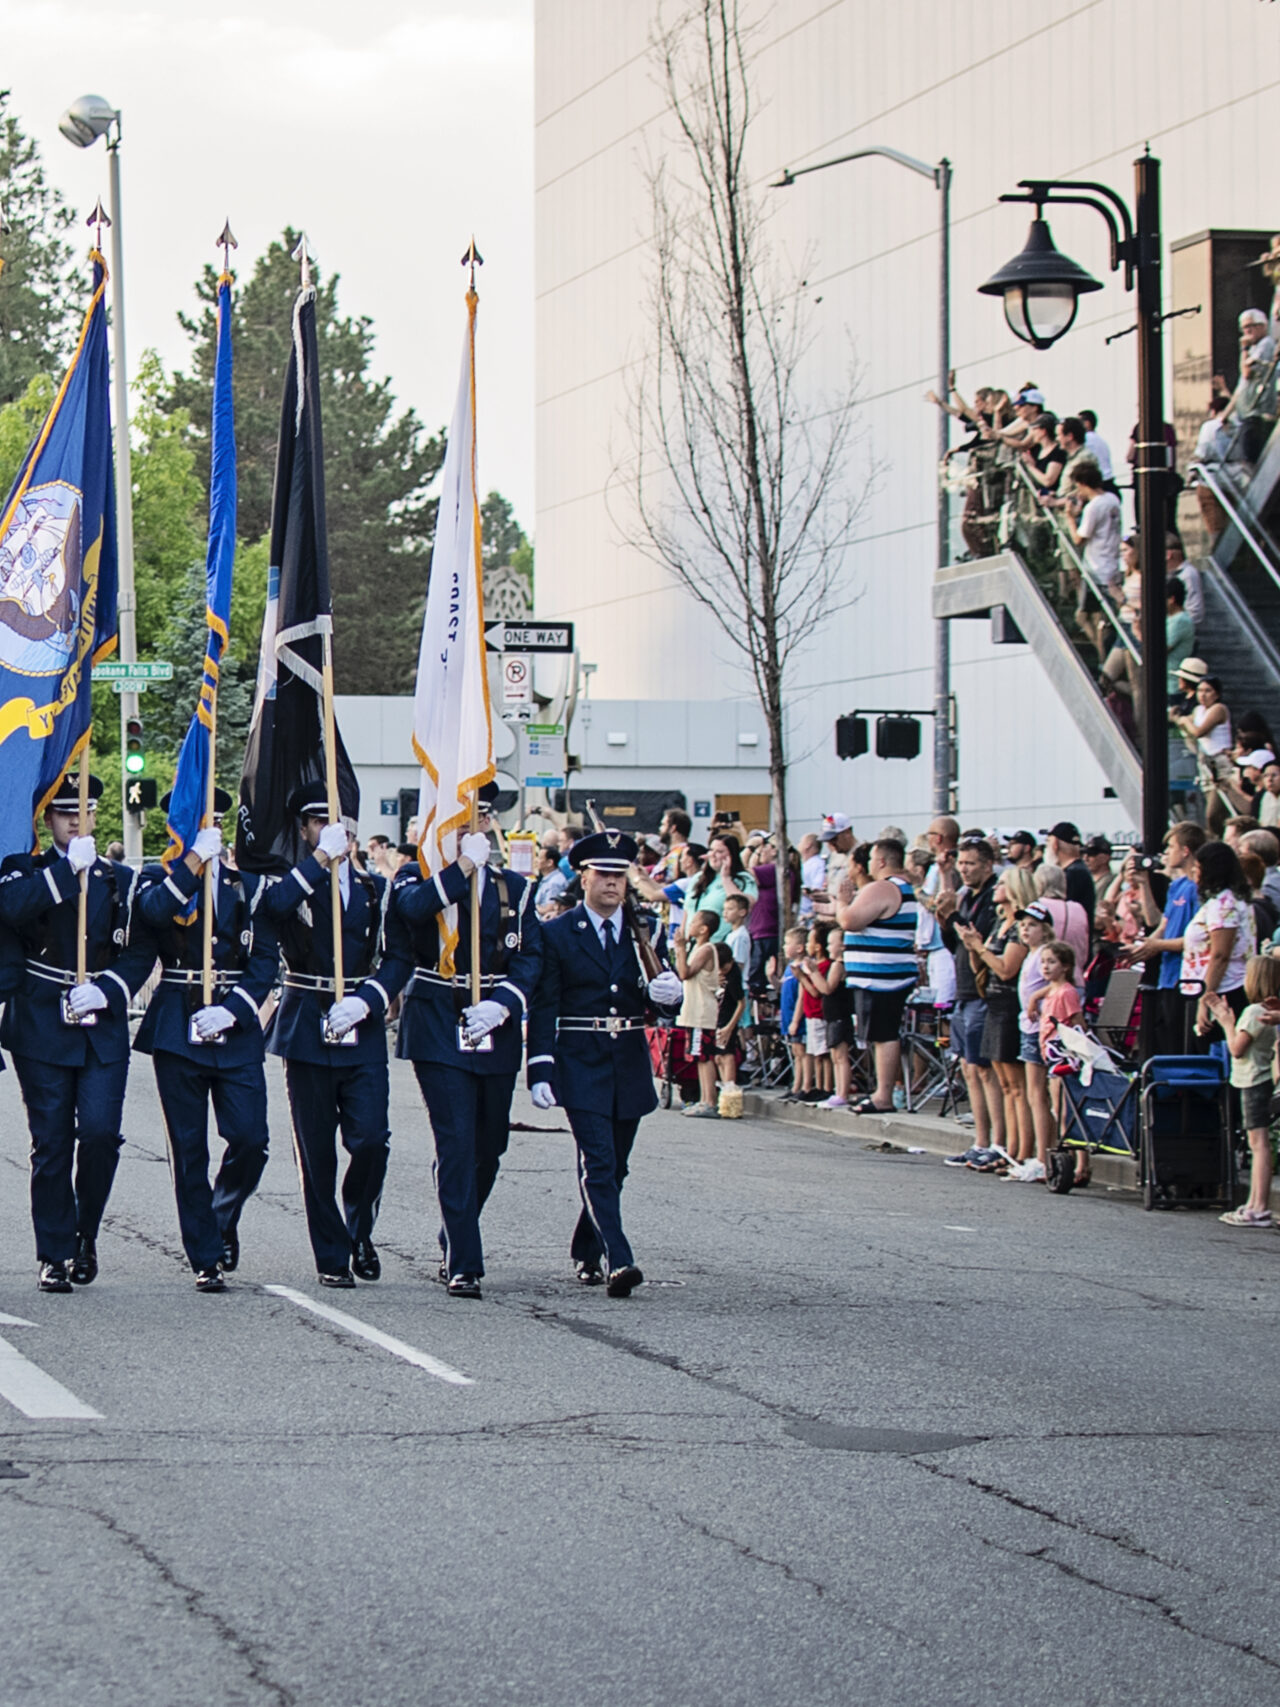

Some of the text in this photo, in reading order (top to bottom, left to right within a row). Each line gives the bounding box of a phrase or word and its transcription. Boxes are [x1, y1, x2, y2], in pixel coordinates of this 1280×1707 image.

[504, 630, 564, 644] ONE WAY
[128, 664, 149, 677] Falls
[151, 664, 171, 676] Blvd
[237, 804, 256, 847] RCE
